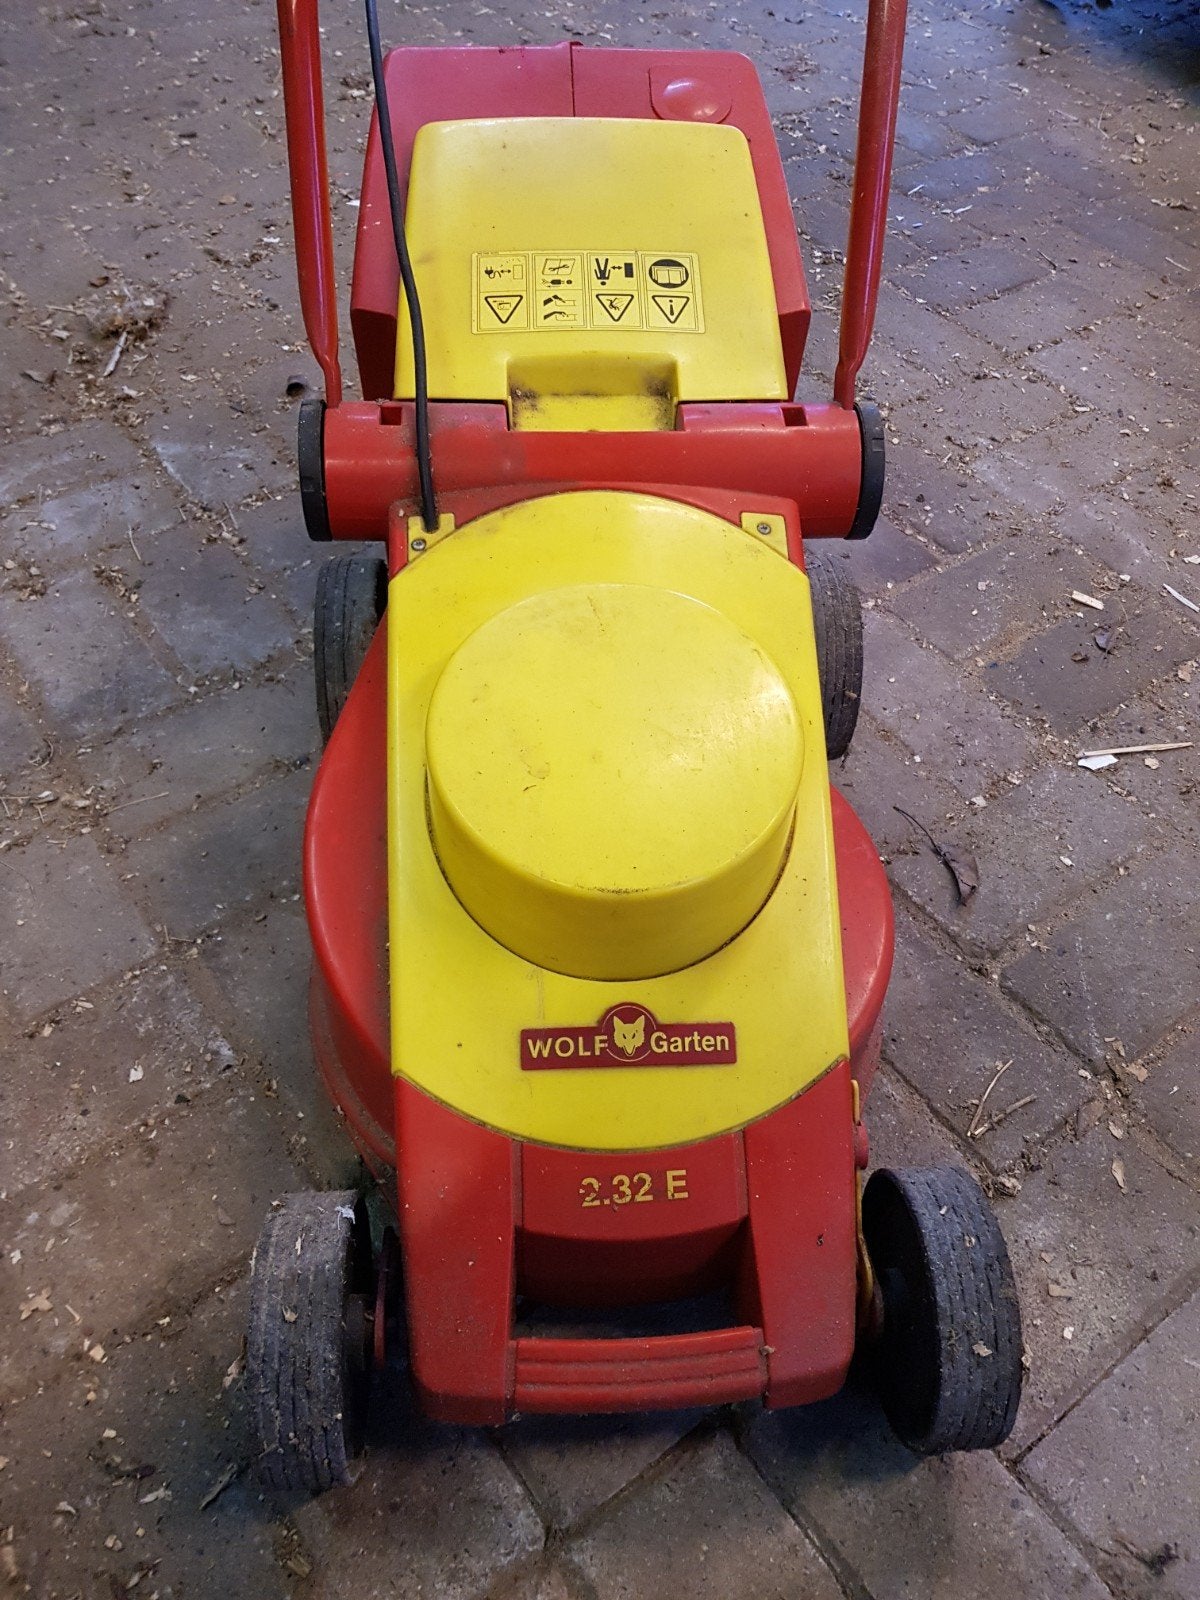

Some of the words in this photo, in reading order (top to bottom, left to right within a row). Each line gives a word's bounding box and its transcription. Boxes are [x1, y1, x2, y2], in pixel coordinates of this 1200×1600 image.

[527, 1035, 608, 1059] WOLF
[650, 1031, 730, 1054] Garten
[579, 1172, 654, 1208] 2.32
[666, 1169, 689, 1200] E
